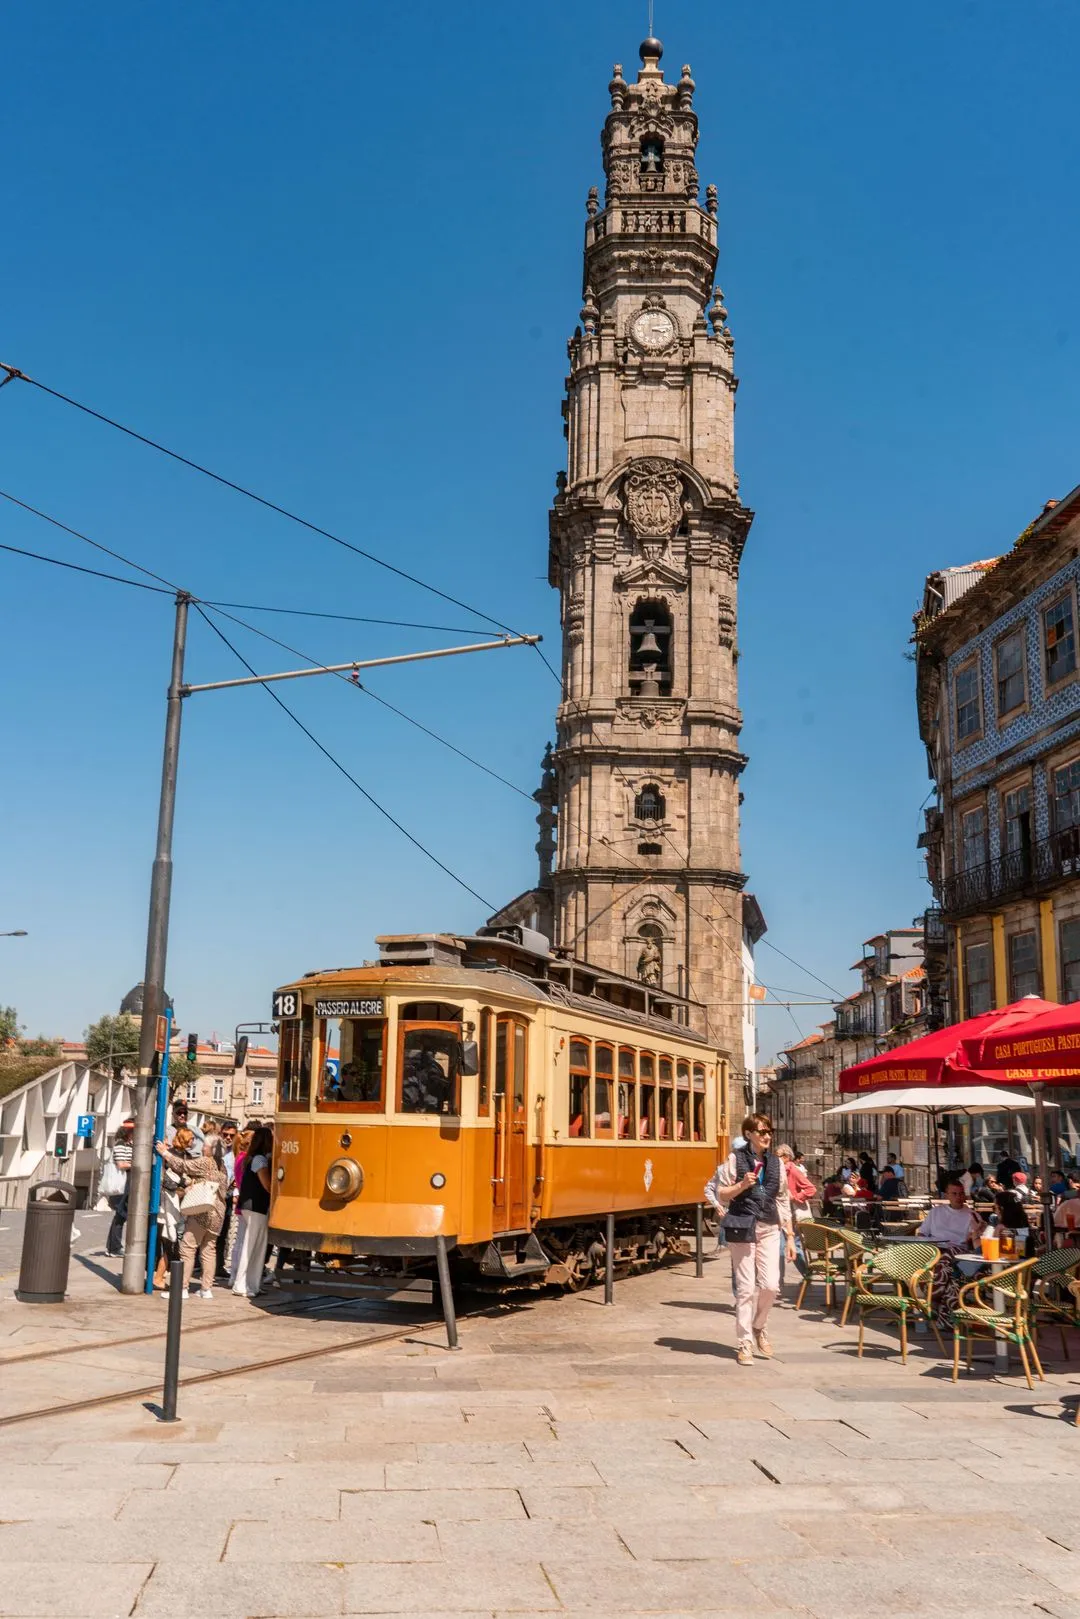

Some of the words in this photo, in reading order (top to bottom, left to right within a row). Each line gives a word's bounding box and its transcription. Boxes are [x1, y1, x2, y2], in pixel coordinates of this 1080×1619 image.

[275, 995, 295, 1016] 18
[317, 1001, 349, 1015] PASSEIO
[350, 1001, 382, 1015] ALEGRE
[995, 1044, 1011, 1059] CASA
[1013, 1037, 1056, 1057] PORTUGUESA
[1006, 1068, 1034, 1079] CASA
[81, 1117, 89, 1128] P
[281, 1140, 299, 1154] 205
